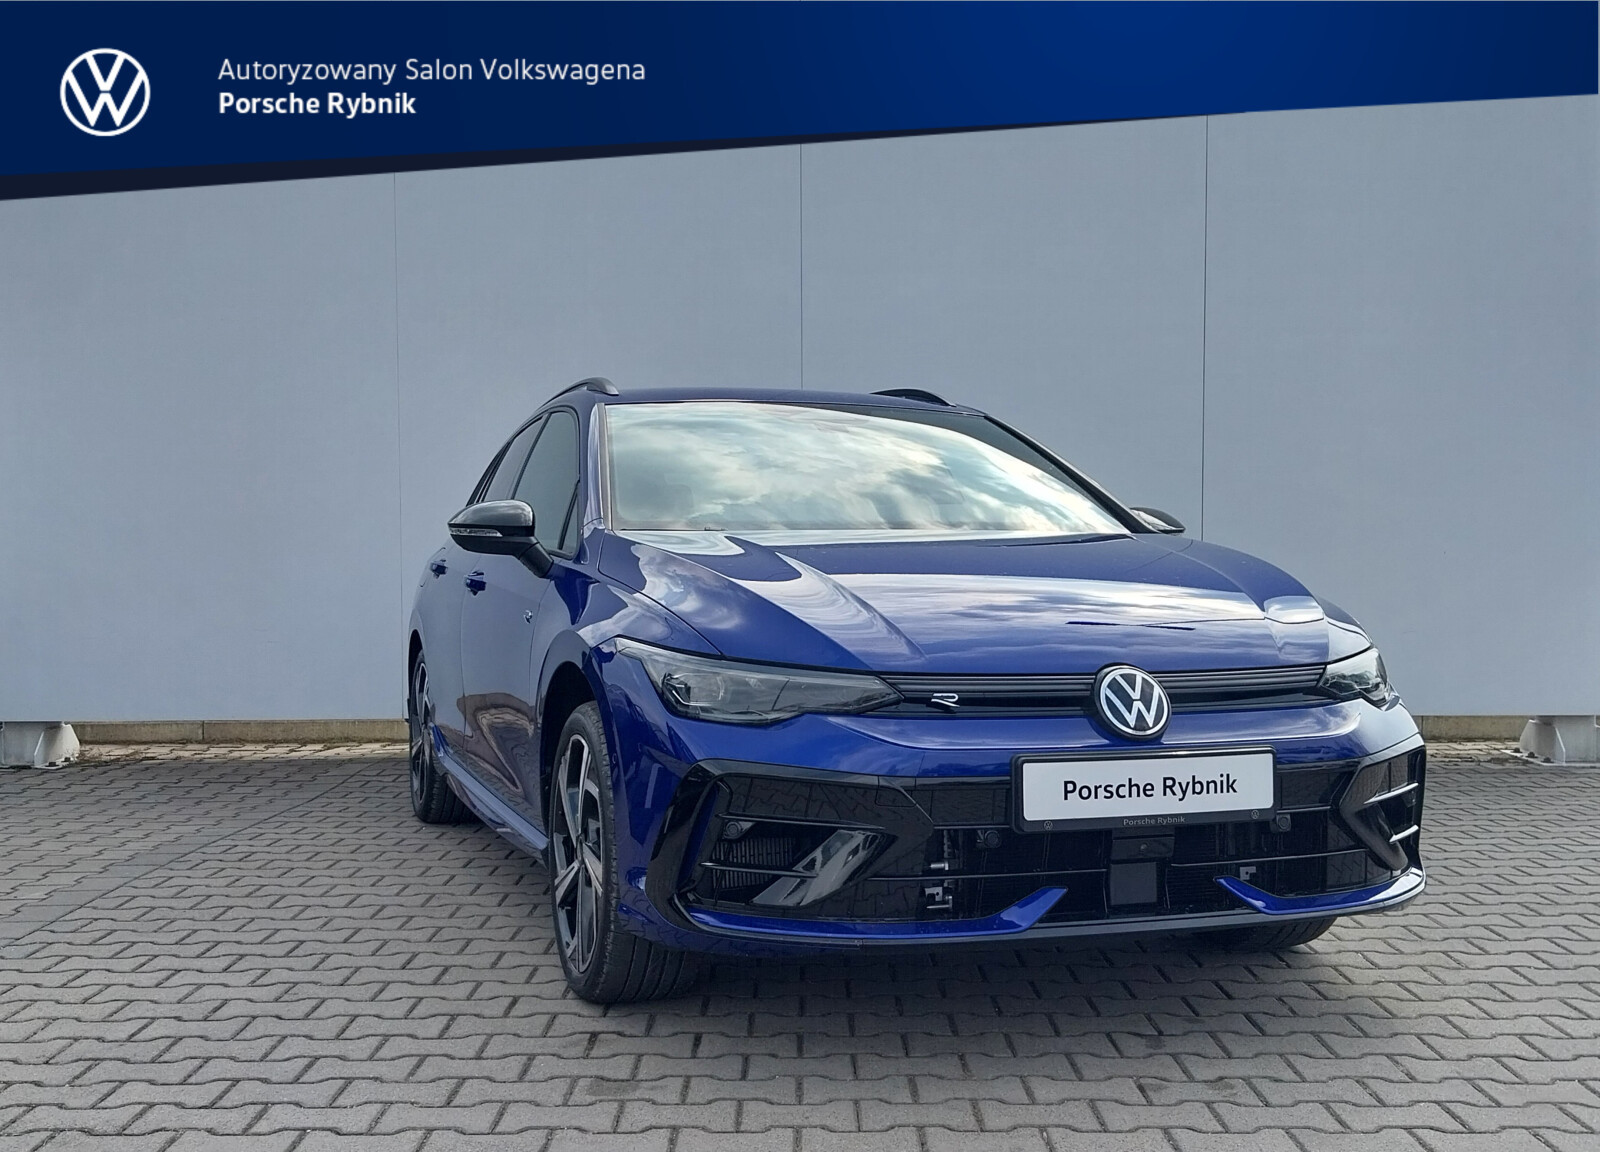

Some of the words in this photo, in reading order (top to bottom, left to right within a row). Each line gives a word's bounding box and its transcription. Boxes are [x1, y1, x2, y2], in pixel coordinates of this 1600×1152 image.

[1062, 777, 1155, 801] Porsche
[1162, 773, 1238, 802] Rybnik
[1123, 817, 1156, 826] Porsche
[1157, 816, 1186, 825] Rybnik
